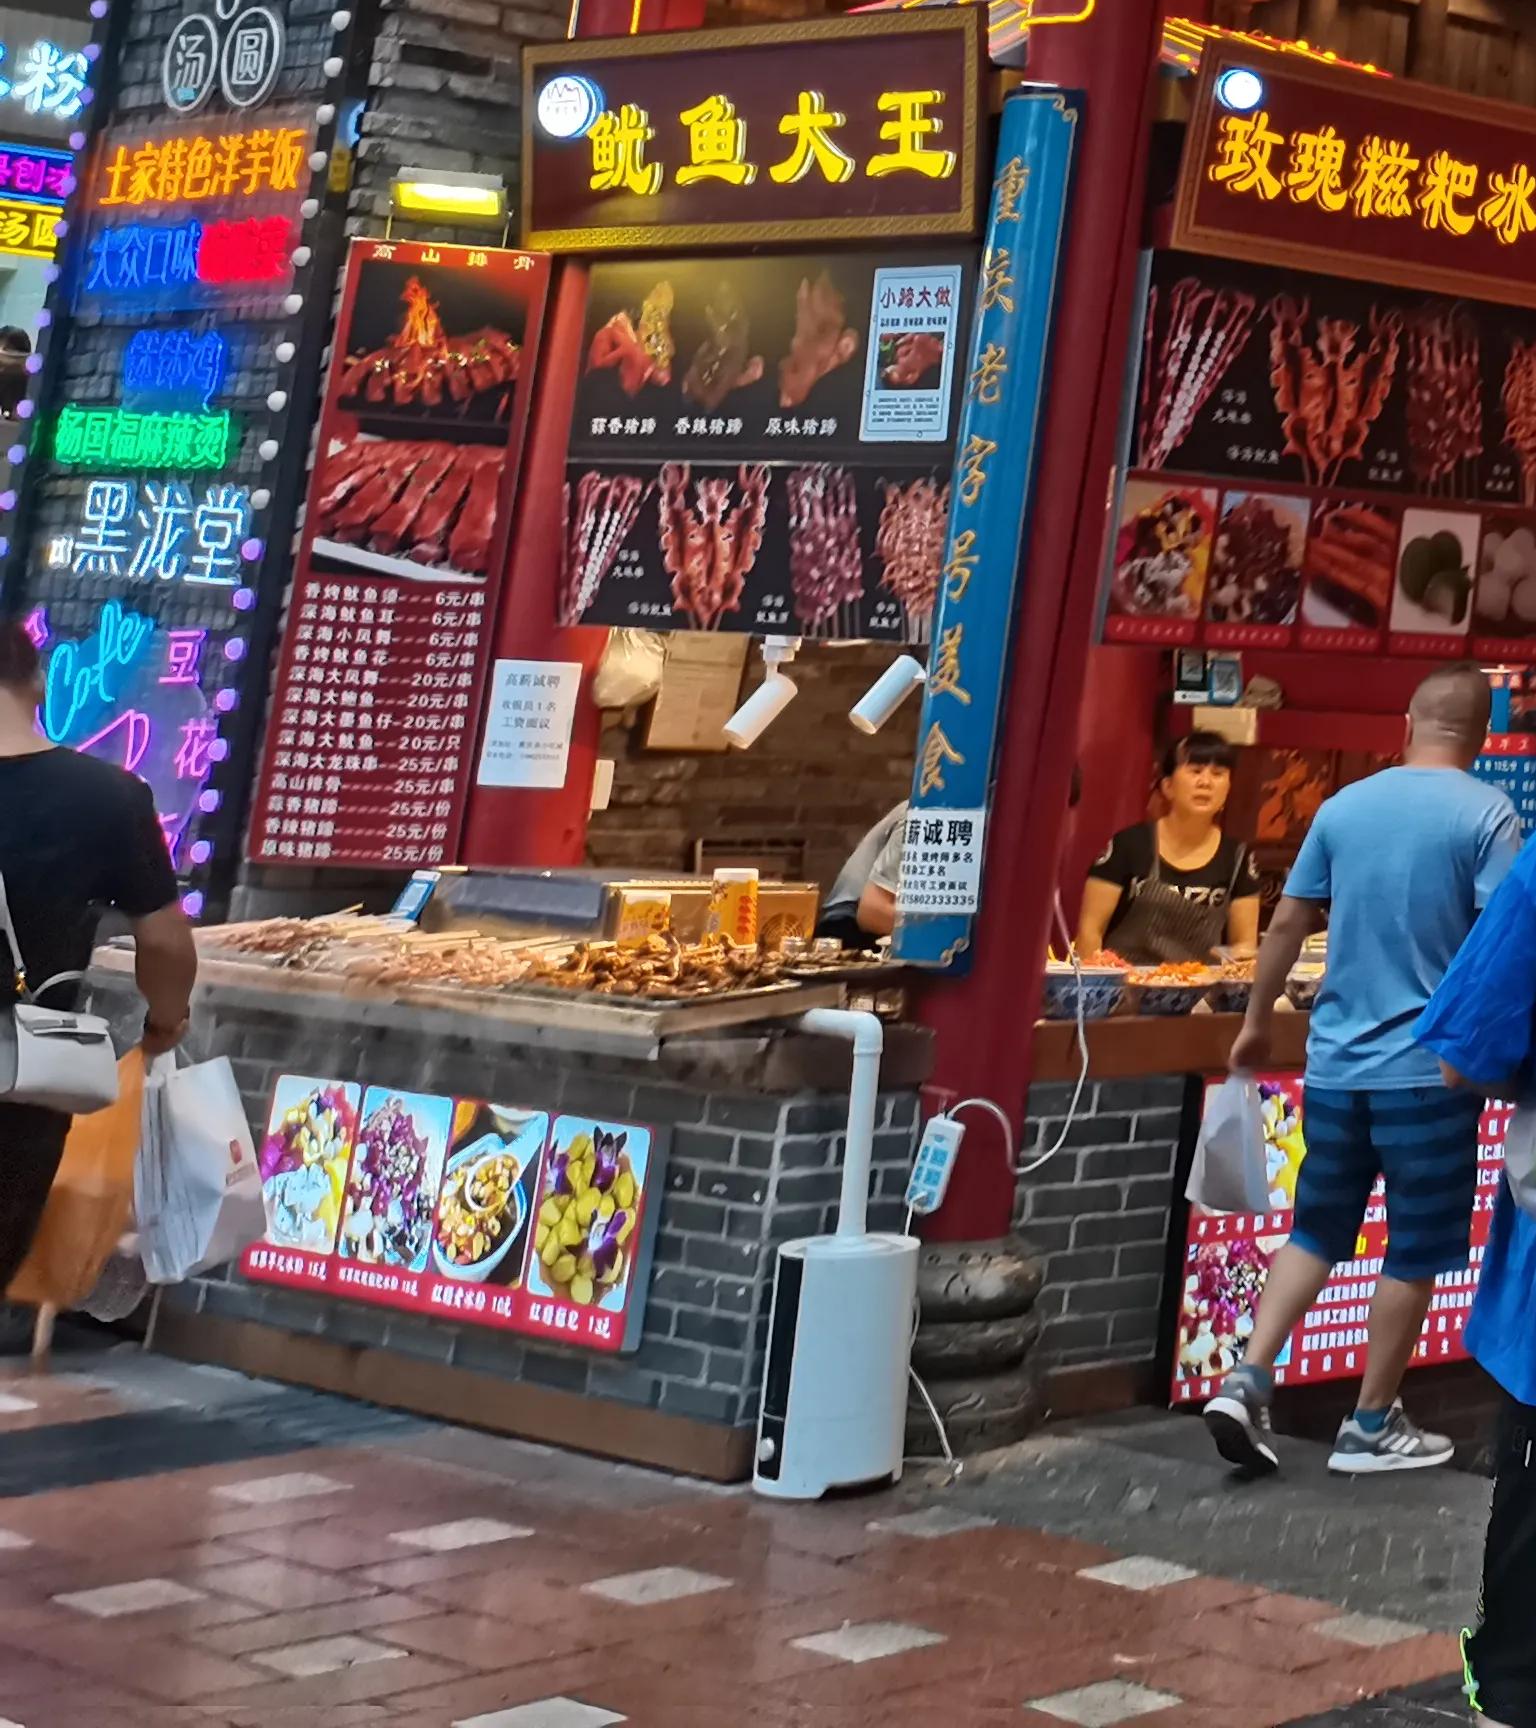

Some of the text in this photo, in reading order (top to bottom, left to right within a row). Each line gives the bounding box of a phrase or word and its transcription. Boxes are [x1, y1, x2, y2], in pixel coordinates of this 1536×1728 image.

[587, 90, 957, 196] 鱿鱼大王
[372, 244, 535, 272] 高山排骨
[56, 405, 230, 469] 杨国福麻辣烫
[915, 157, 1029, 796] 重庆老字号美食
[903, 819, 973, 846] 薪诚聘
